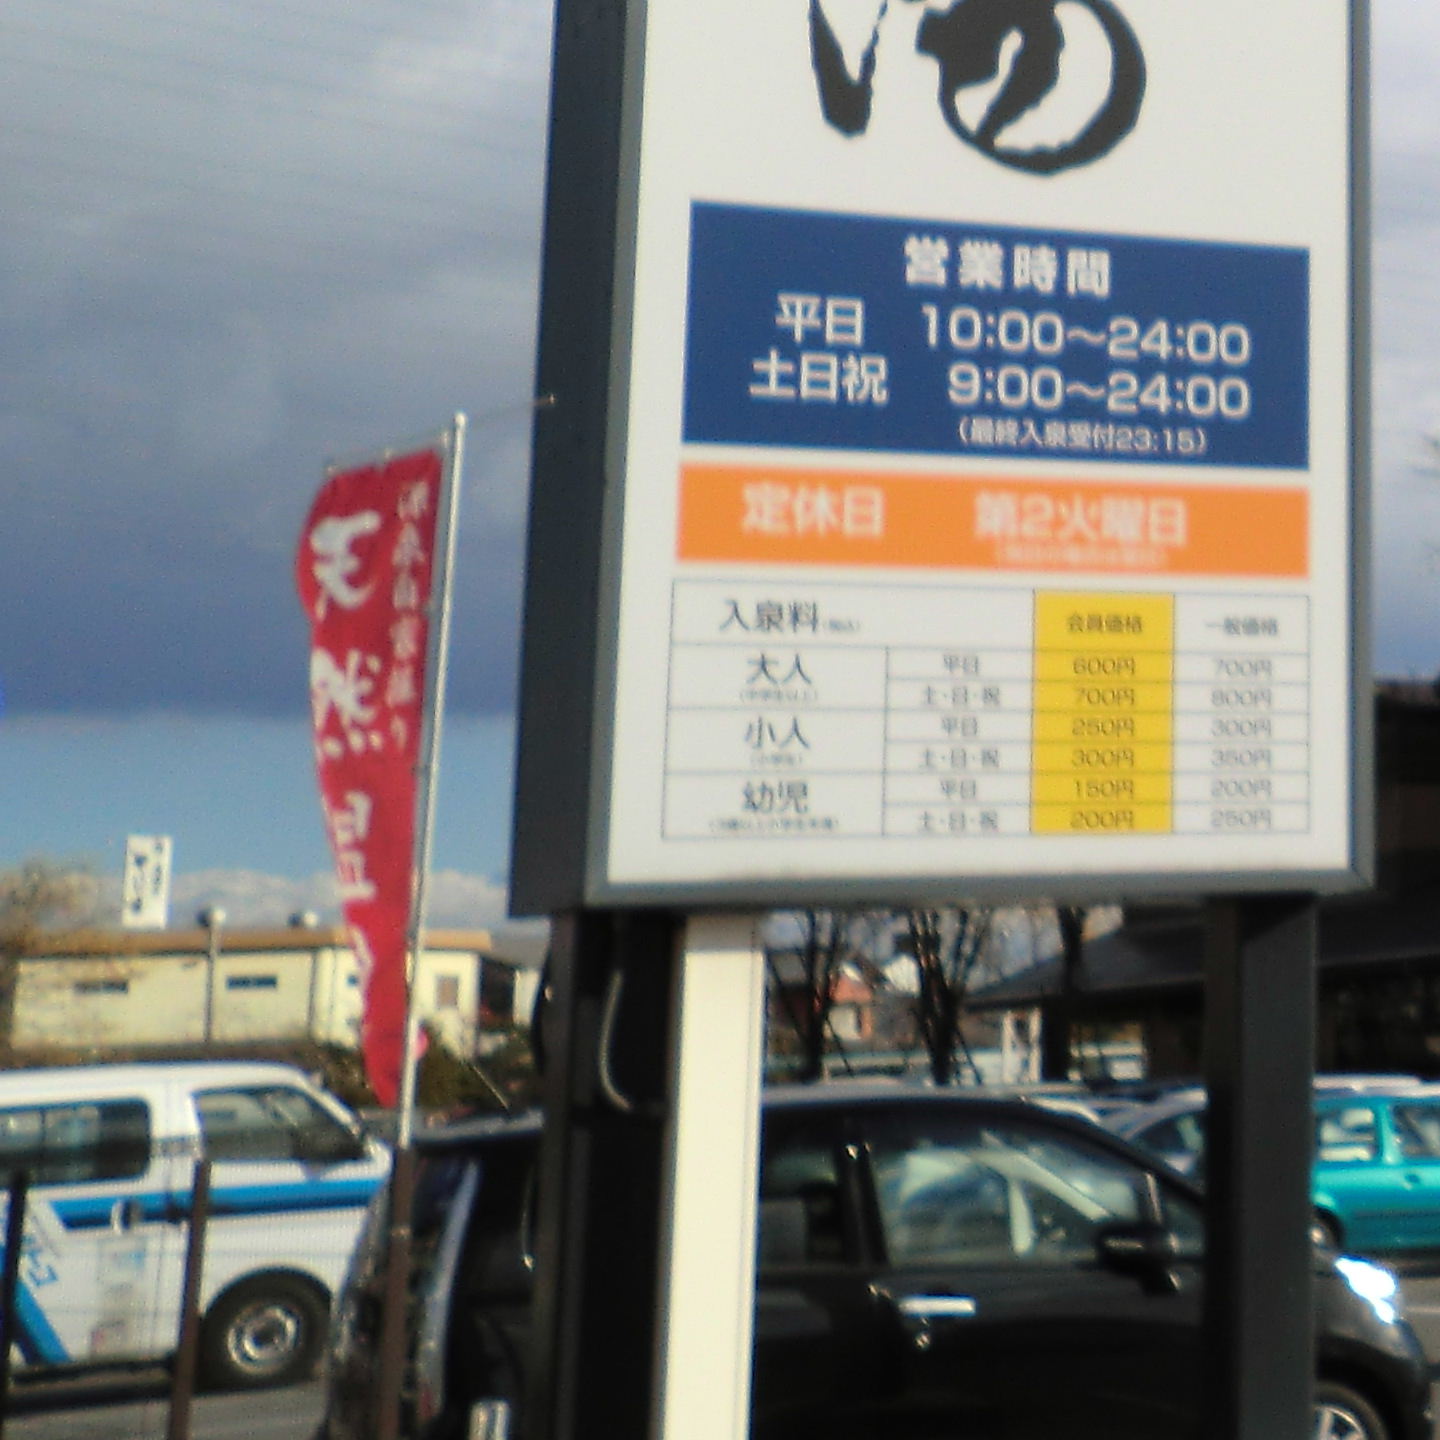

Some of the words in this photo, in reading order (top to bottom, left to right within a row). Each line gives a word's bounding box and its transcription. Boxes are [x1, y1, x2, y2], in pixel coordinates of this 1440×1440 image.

[904, 235, 1110, 298] 営業時間
[775, 293, 864, 347] 平日
[749, 349, 888, 404] 土日祝
[741, 482, 886, 538] 定休日
[719, 600, 818, 633] 入泉料
[746, 653, 812, 684] 大人
[744, 716, 811, 749] 小人
